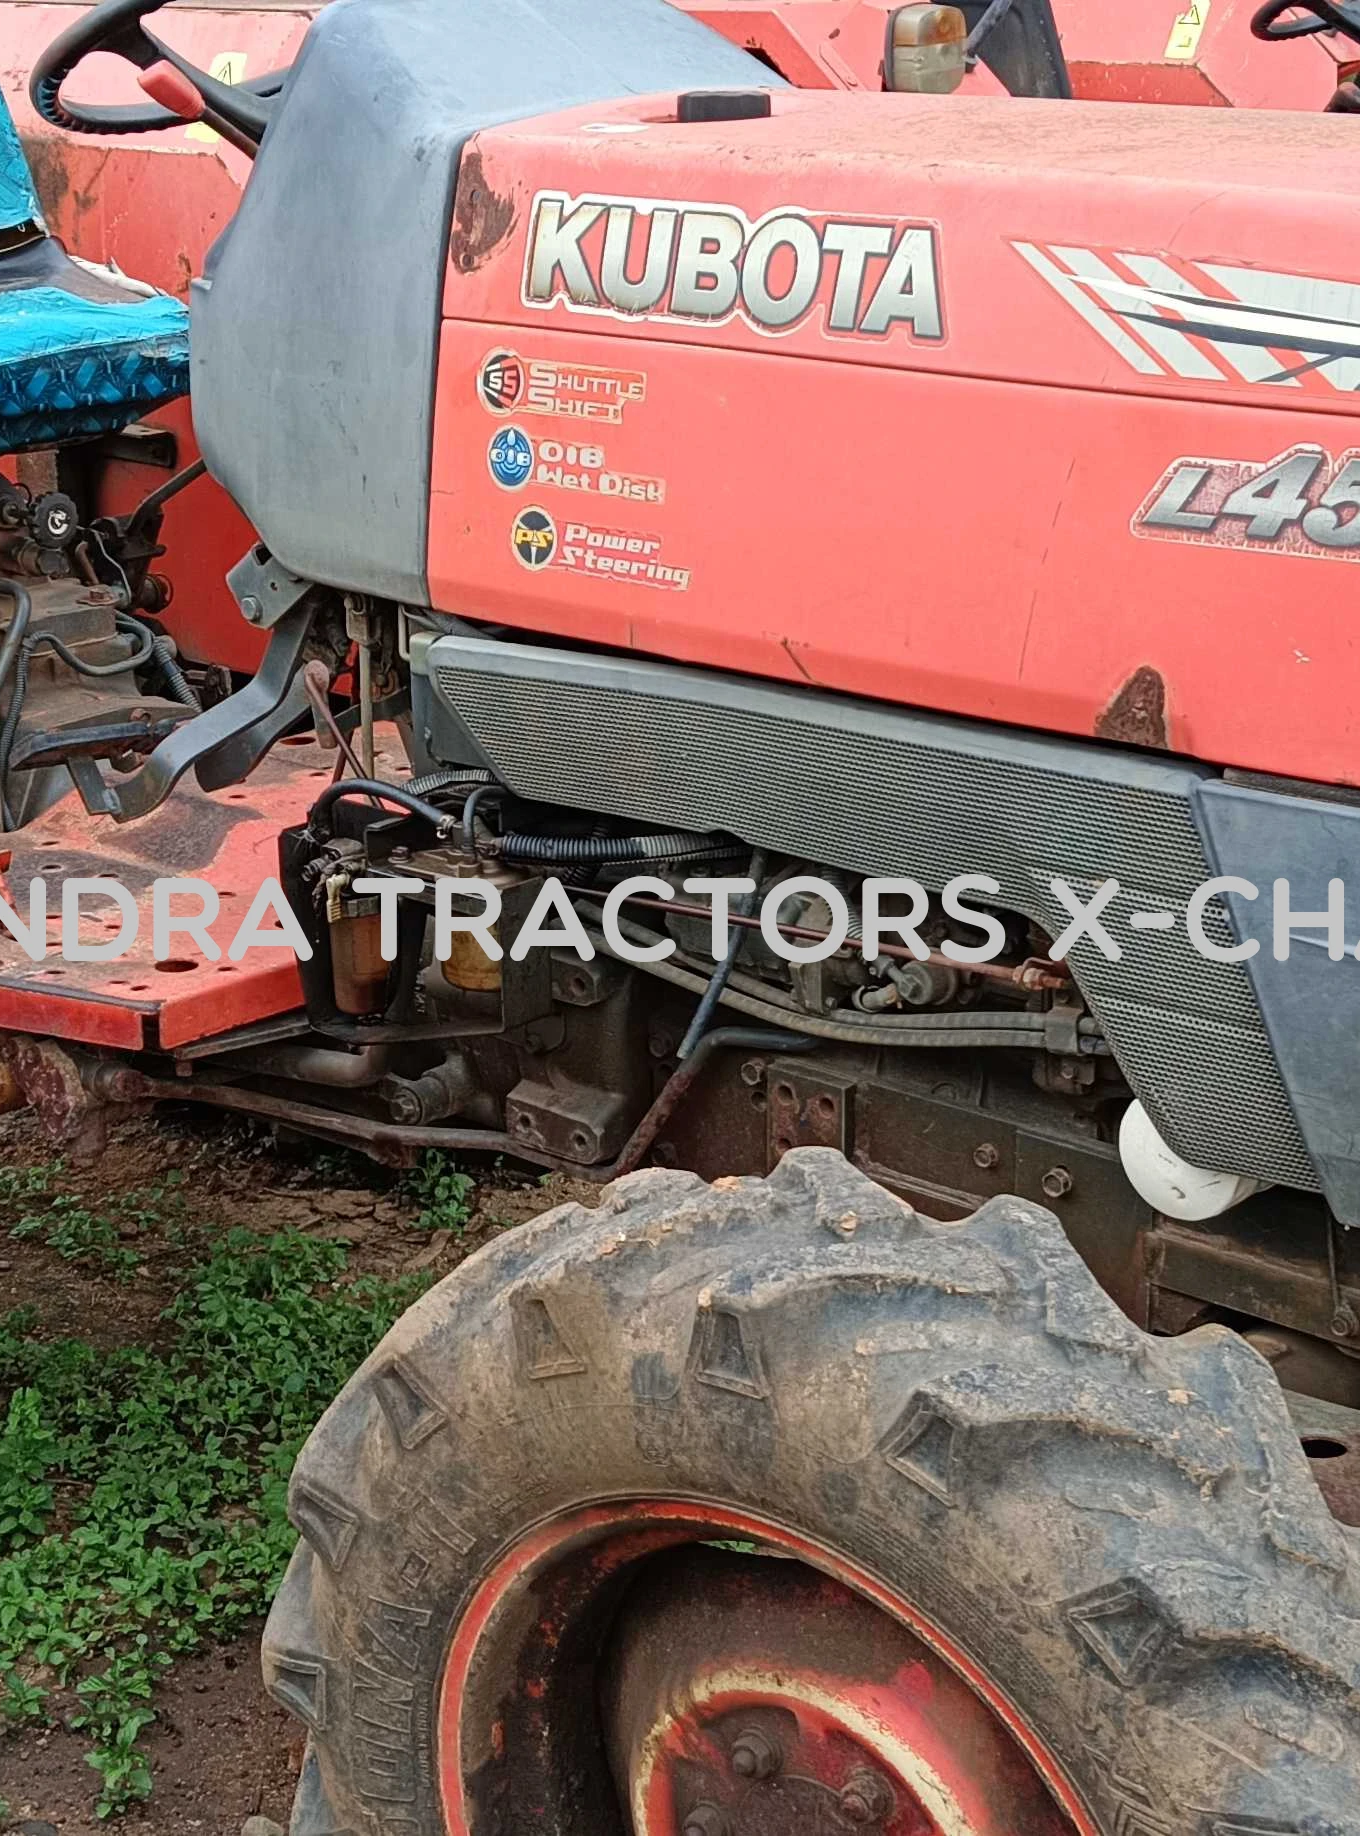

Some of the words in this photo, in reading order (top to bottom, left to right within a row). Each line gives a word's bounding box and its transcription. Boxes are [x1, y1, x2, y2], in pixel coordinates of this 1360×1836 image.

[526, 197, 946, 341] KUBOTA
[528, 361, 643, 400] SHUTTLE
[526, 387, 621, 421] SHIFT
[536, 463, 591, 489] Wet
[598, 473, 664, 502] Disk
[563, 523, 661, 555] Power
[558, 545, 691, 590] Steering
